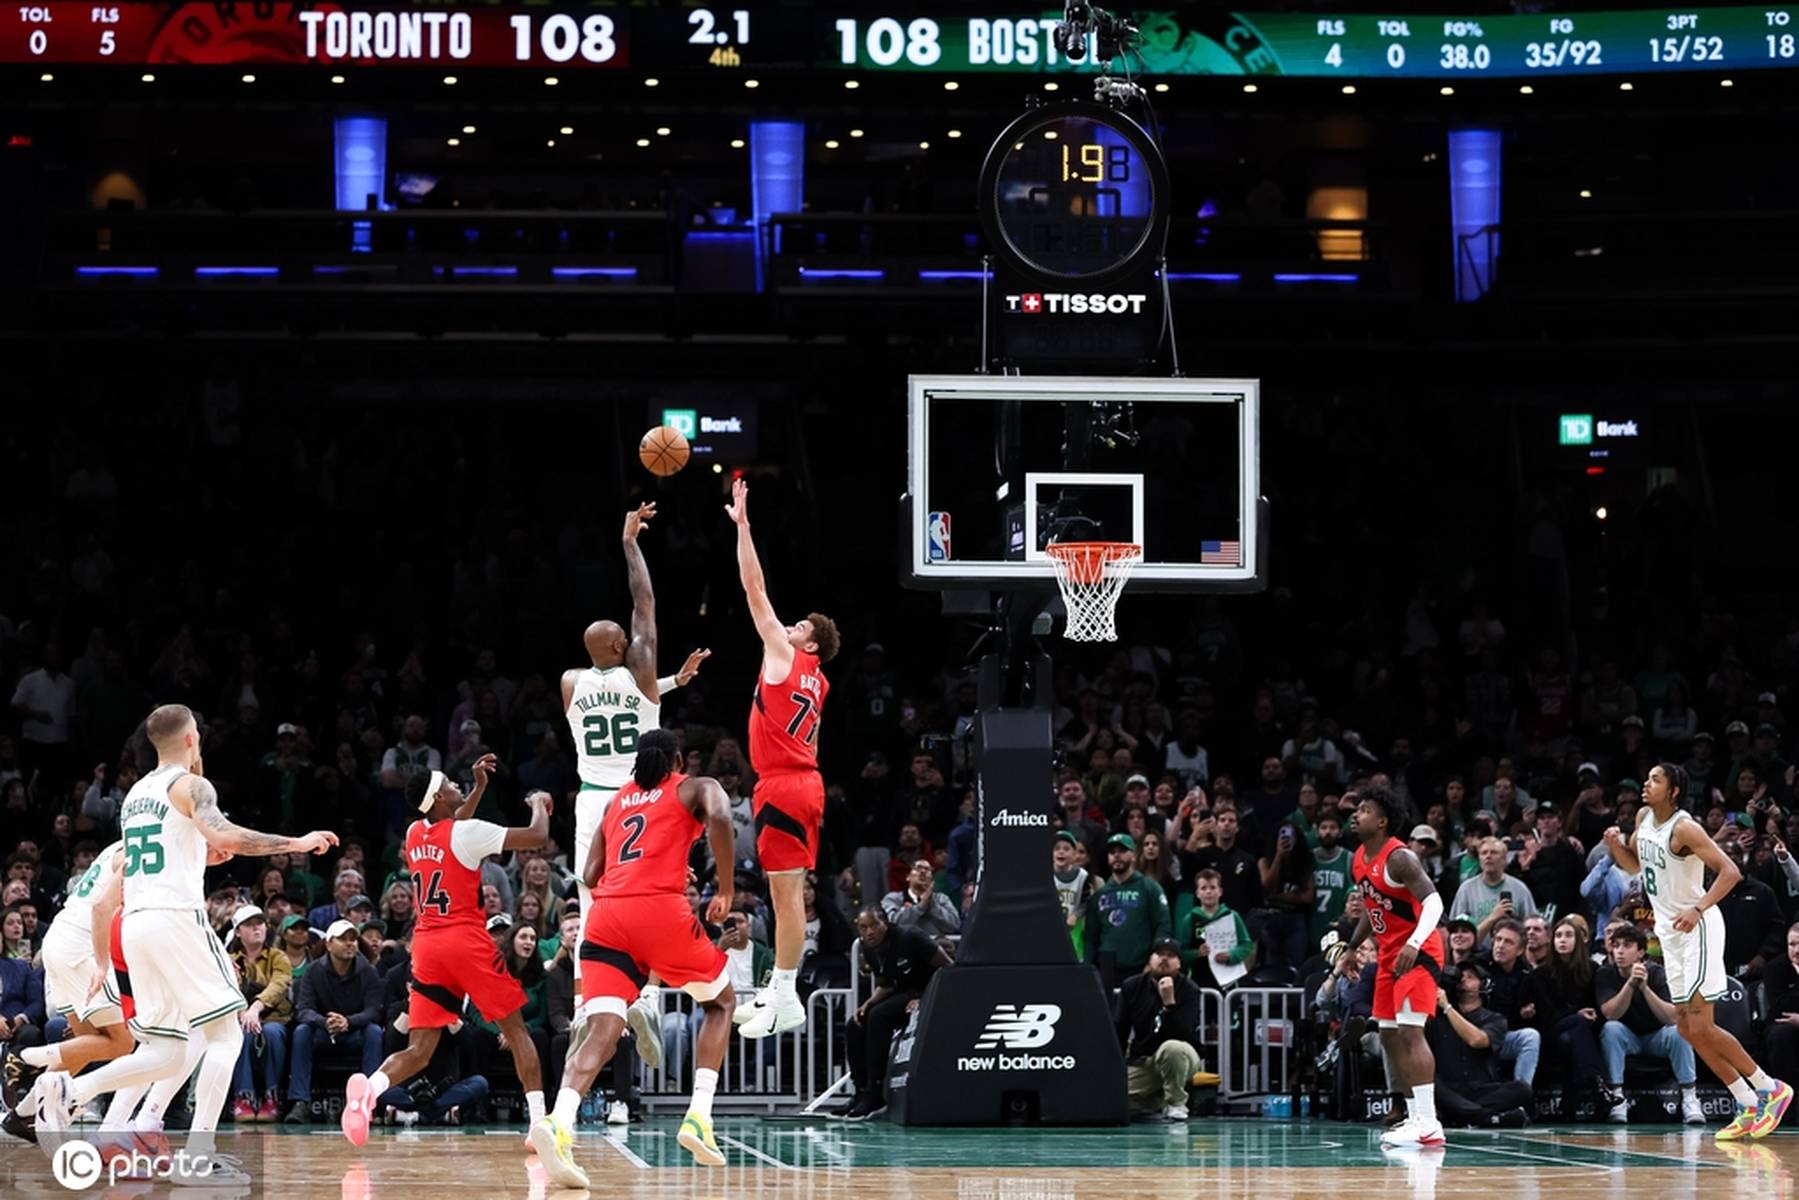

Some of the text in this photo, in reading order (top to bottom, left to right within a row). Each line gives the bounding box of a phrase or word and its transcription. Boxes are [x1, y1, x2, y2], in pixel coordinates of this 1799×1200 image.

[20, 8, 119, 23] TOL FLS
[688, 9, 749, 44] 2.1
[1318, 12, 1790, 37] FLS TOL FG% FG 3PT TO
[30, 30, 115, 55] 0 5
[299, 12, 616, 62] TORONTO 108
[836, 18, 941, 66] 108
[709, 46, 740, 67] 4th
[1324, 34, 1796, 69] 4 0 38.0 35/92 15/52 18
[1062, 144, 1104, 182] 1.9
[1043, 294, 1146, 313] TISSOT
[700, 416, 741, 433] Bank
[1561, 419, 1638, 439] TD Bank
[574, 691, 621, 713] TILLMAN
[583, 712, 640, 756] 26
[991, 809, 1048, 826] Amica
[123, 823, 165, 877] 55
[618, 813, 647, 865] 2
[409, 844, 446, 864] WALTER
[411, 869, 451, 916] 14
[1316, 889, 1332, 913] 7
[974, 1003, 1062, 1048] NB
[957, 1053, 1076, 1071] new balance
